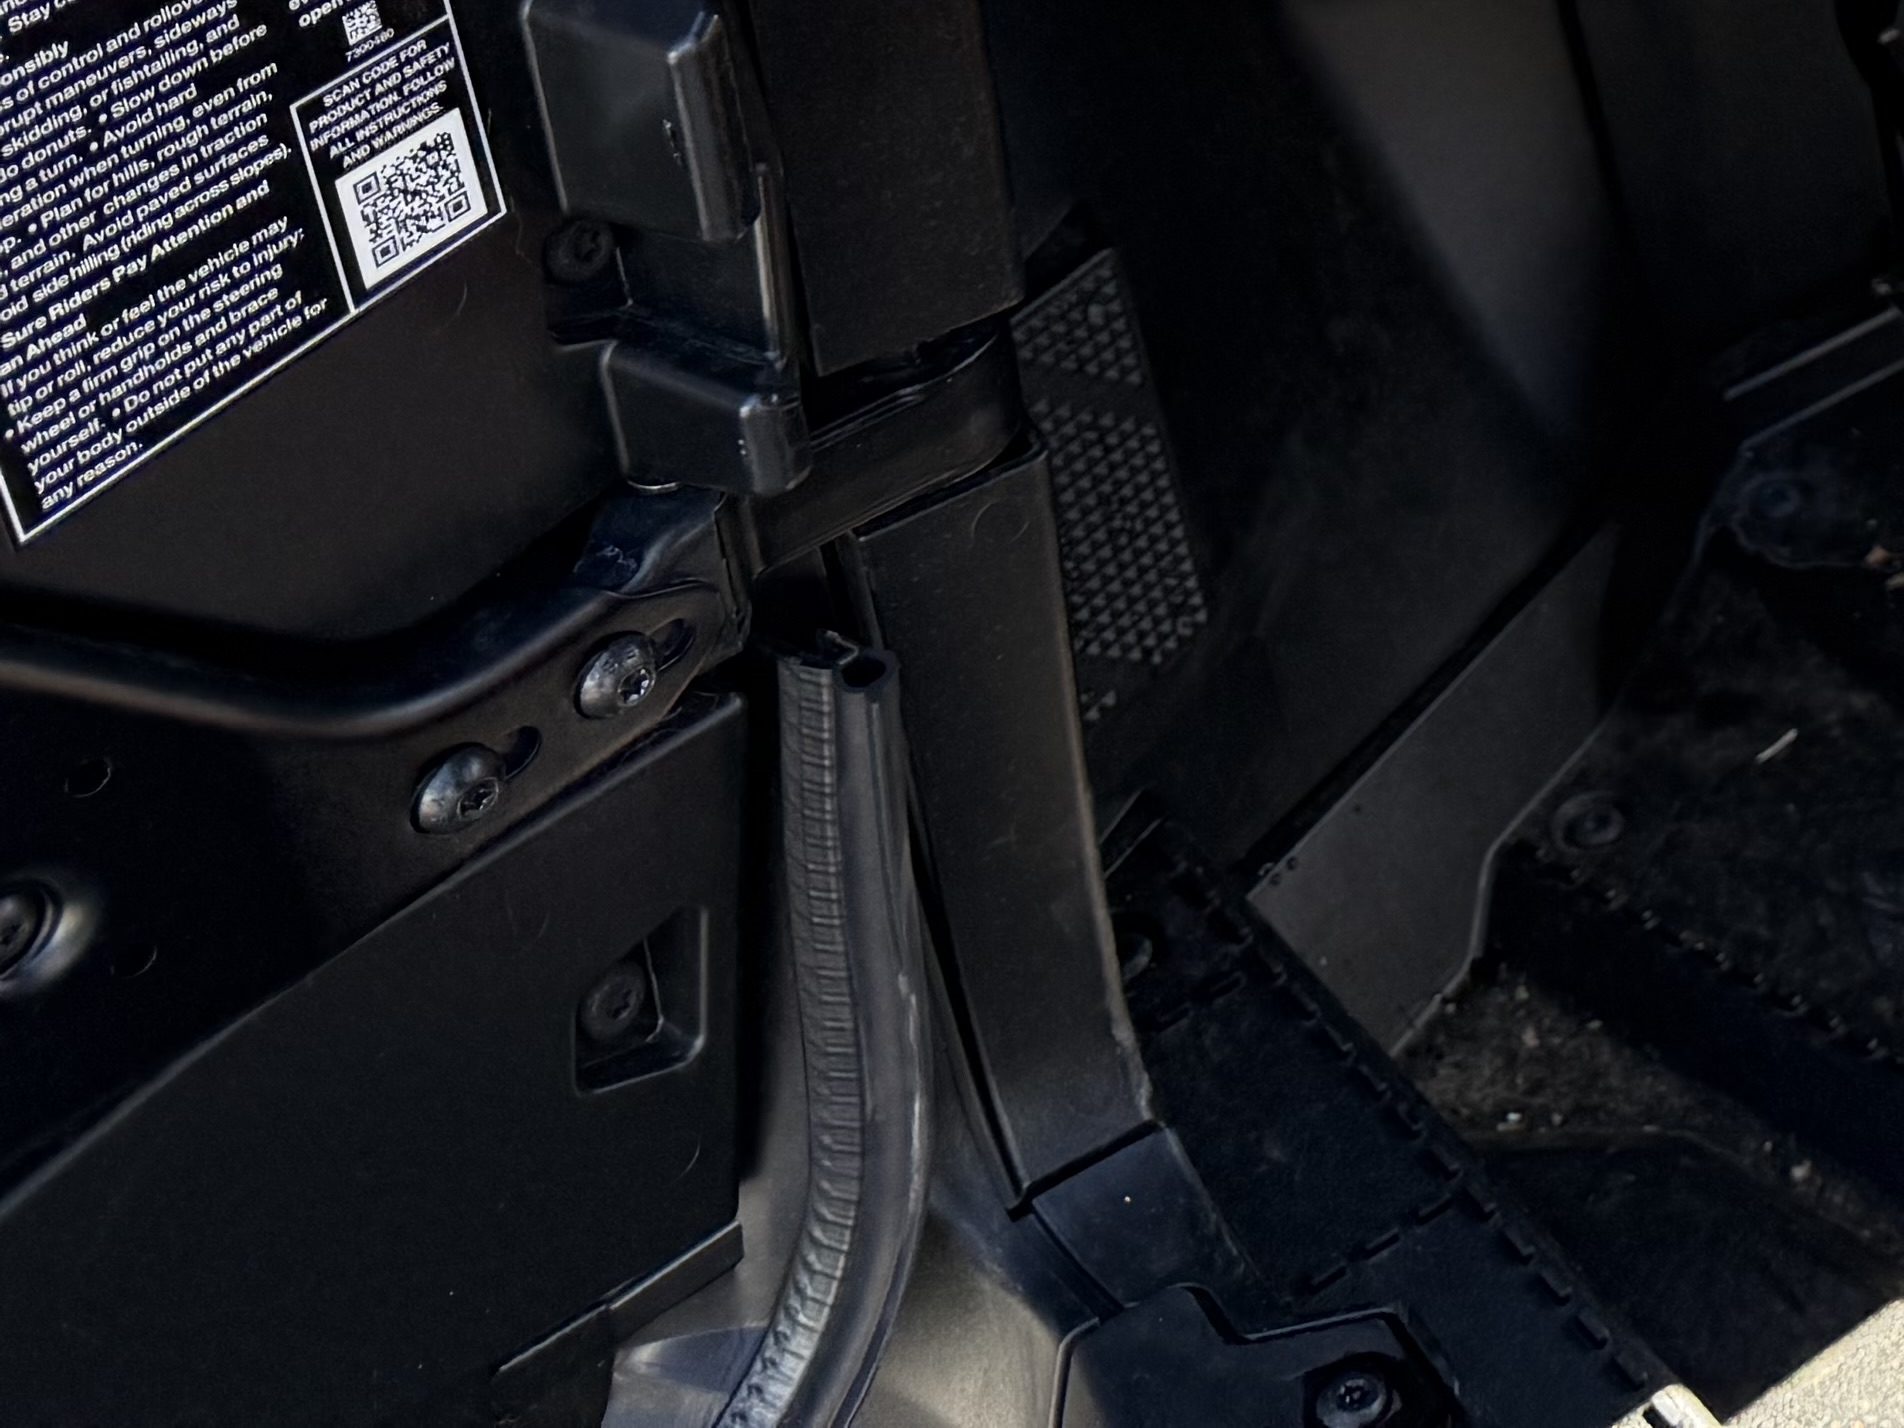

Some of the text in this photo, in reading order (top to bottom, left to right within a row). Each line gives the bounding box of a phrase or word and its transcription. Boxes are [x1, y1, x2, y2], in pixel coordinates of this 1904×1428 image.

[6, 1, 50, 33] Stay
[37, 42, 104, 90] control
[105, 21, 141, 53] and
[44, 45, 152, 109] maneuvers,
[321, 38, 427, 107] SCAN CODE FOR
[0, 104, 88, 157] skidding,
[110, 38, 204, 95] fishtailing,
[204, 12, 240, 43] and
[20, 125, 92, 169] donuts.
[109, 84, 155, 119] Slow
[157, 56, 209, 92] down
[208, 23, 267, 64] before
[37, 152, 83, 183] turn.
[102, 106, 155, 148] Avoid
[154, 81, 197, 116] hard
[67, 61, 278, 189] when turning, even from
[308, 41, 450, 134] PRODUCT AND SAFETY
[309, 56, 455, 151] INFORMATION. FOLLOW
[328, 79, 447, 159] ALL INSTRUCTIONS
[342, 101, 443, 169] AND WARNINGS.
[8, 133, 269, 292] terrain. Avoid paved surfaces
[9, 237, 47, 270] and
[47, 209, 97, 247] other
[102, 163, 180, 215] changes
[199, 112, 268, 158] traction
[39, 90, 273, 229] Plan for hills, rough terrain,
[119, 211, 174, 253] (riding
[173, 178, 230, 219] across
[228, 142, 292, 186] slopes).
[0, 178, 270, 349] Sure Riders Pay Attention and
[15, 359, 52, 392] you
[51, 330, 100, 366] think
[120, 293, 156, 324] feel
[155, 277, 186, 303] the
[187, 239, 250, 283] vehicle
[250, 215, 288, 246] may
[6, 394, 33, 417] tip
[55, 358, 92, 387] roll,
[92, 319, 156, 365] reduce
[156, 292, 196, 328] your
[197, 272, 231, 300] risk
[15, 396, 67, 434] Keep
[81, 364, 119, 393] firm
[119, 341, 156, 373] grip
[156, 325, 181, 347] on
[181, 306, 211, 332] the
[211, 262, 283, 313] steering
[20, 410, 76, 454] wheel
[97, 340, 193, 406] handholds
[193, 315, 228, 347] and
[227, 286, 278, 325] brace
[25, 312, 87, 361] Ahead
[26, 416, 106, 477] yourself.
[122, 388, 151, 413] Do
[151, 367, 183, 395] not
[182, 347, 214, 378] put
[214, 327, 246, 356] any
[247, 303, 284, 338] part
[33, 457, 75, 495] your
[75, 427, 123, 465] body
[124, 385, 191, 433] outside
[210, 353, 241, 378] the
[241, 314, 302, 358] vehicle
[302, 297, 328, 320] for
[40, 440, 143, 510] any reason.
